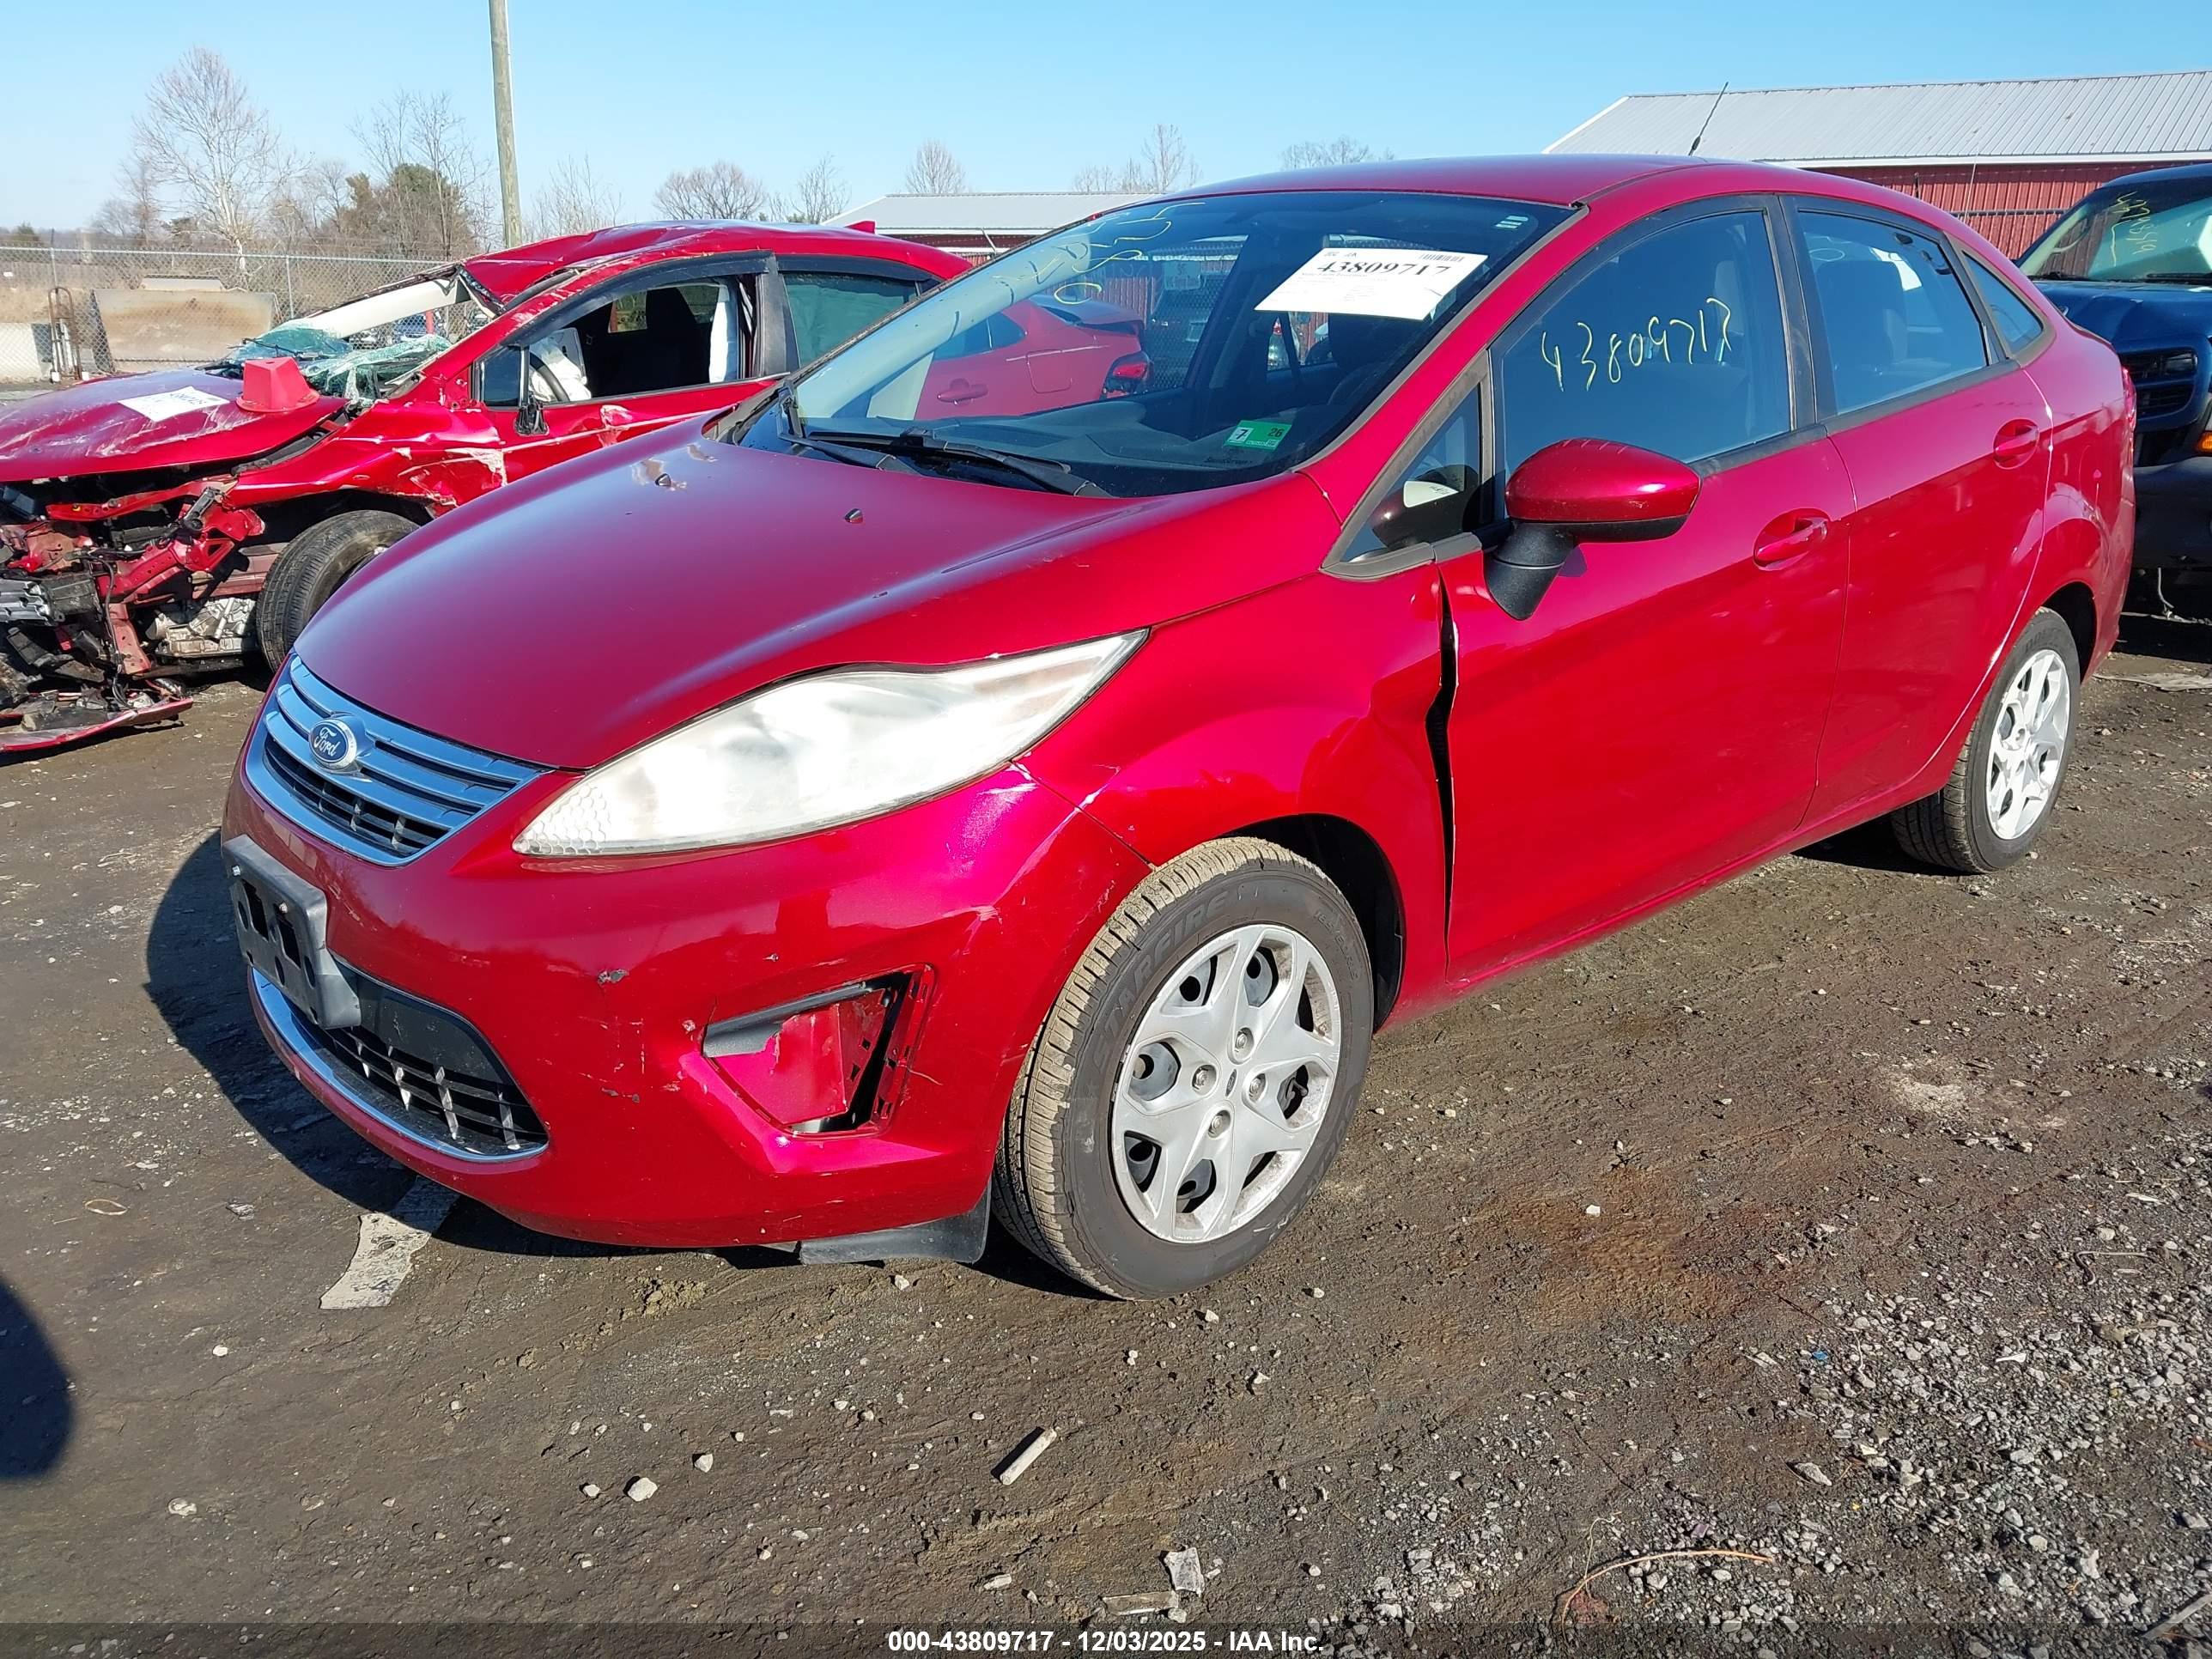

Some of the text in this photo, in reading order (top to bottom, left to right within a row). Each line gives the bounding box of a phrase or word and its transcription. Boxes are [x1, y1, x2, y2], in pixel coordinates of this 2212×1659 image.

[1317, 260, 1452, 276] 43809717
[1541, 297, 1732, 392] 43809717
[1268, 428, 1284, 438] 26
[313, 726, 341, 757] Ford
